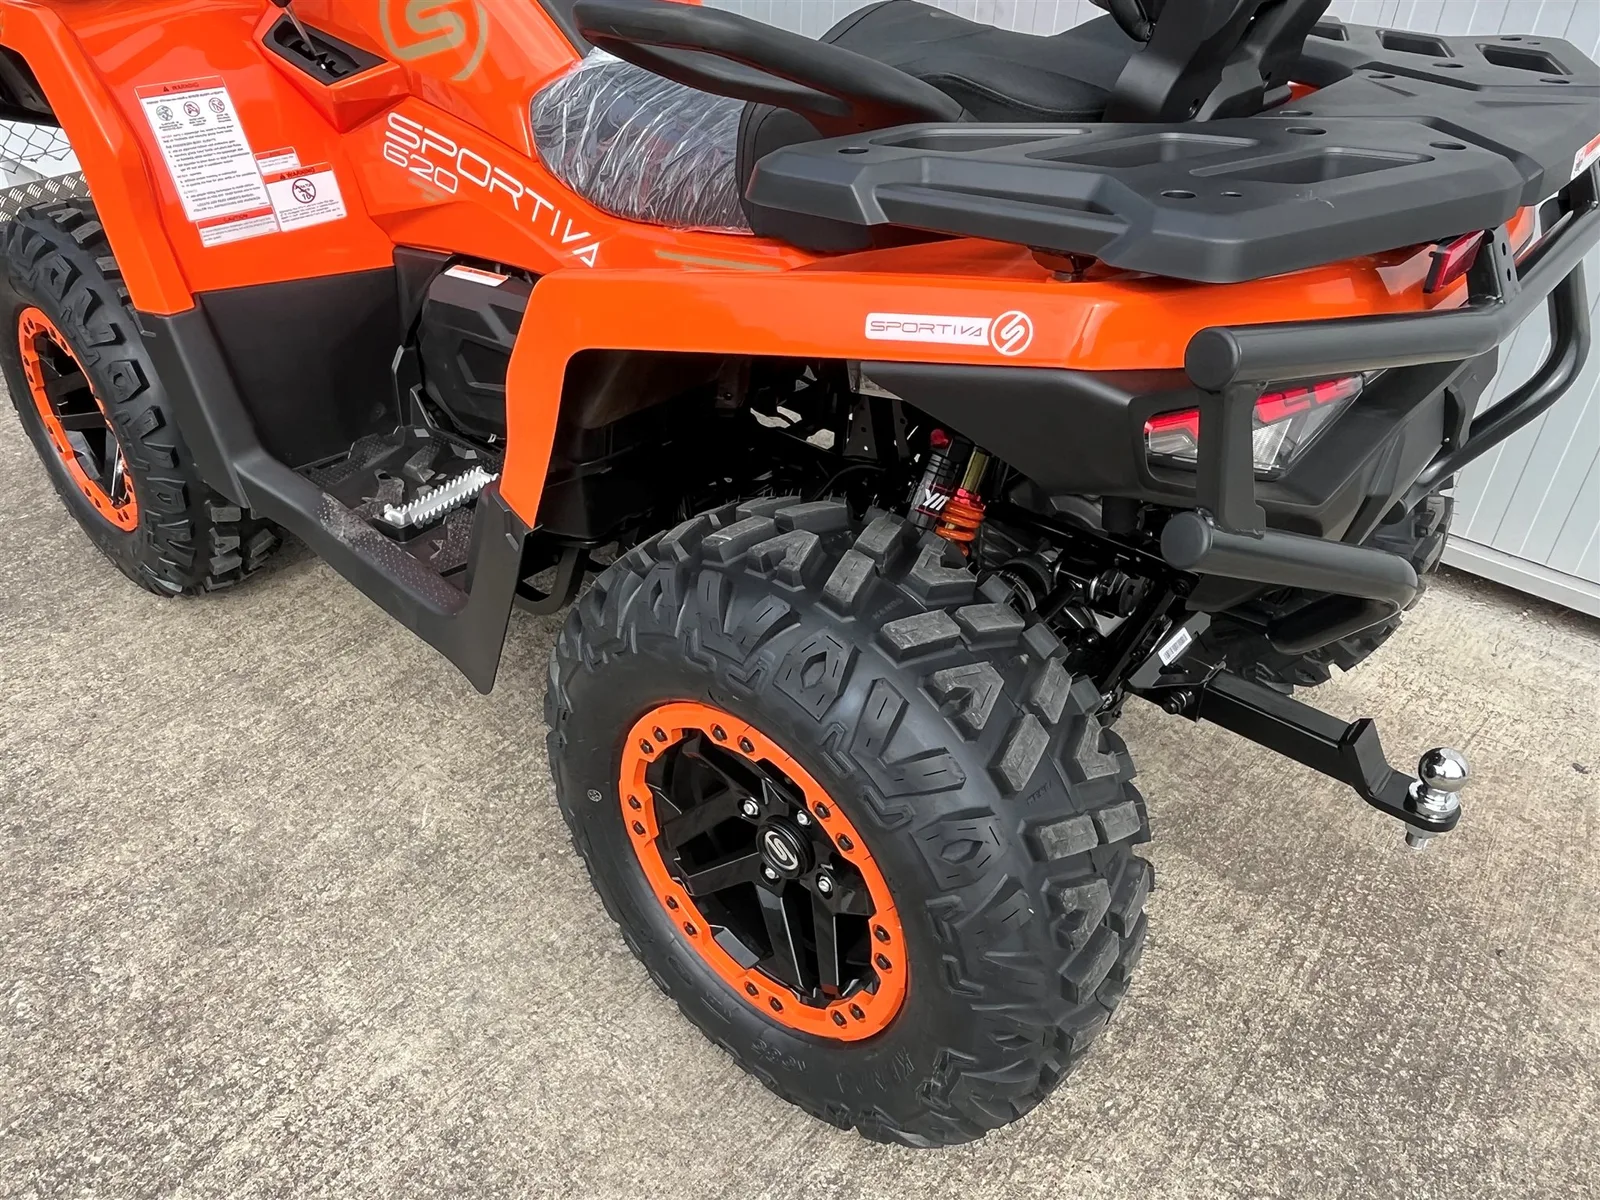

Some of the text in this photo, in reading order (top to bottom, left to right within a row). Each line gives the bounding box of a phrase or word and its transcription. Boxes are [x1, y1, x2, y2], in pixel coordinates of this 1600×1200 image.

[383, 141, 458, 194] 620
[385, 112, 600, 268] SPORTIVA
[870, 320, 983, 337] SPORTIVA
